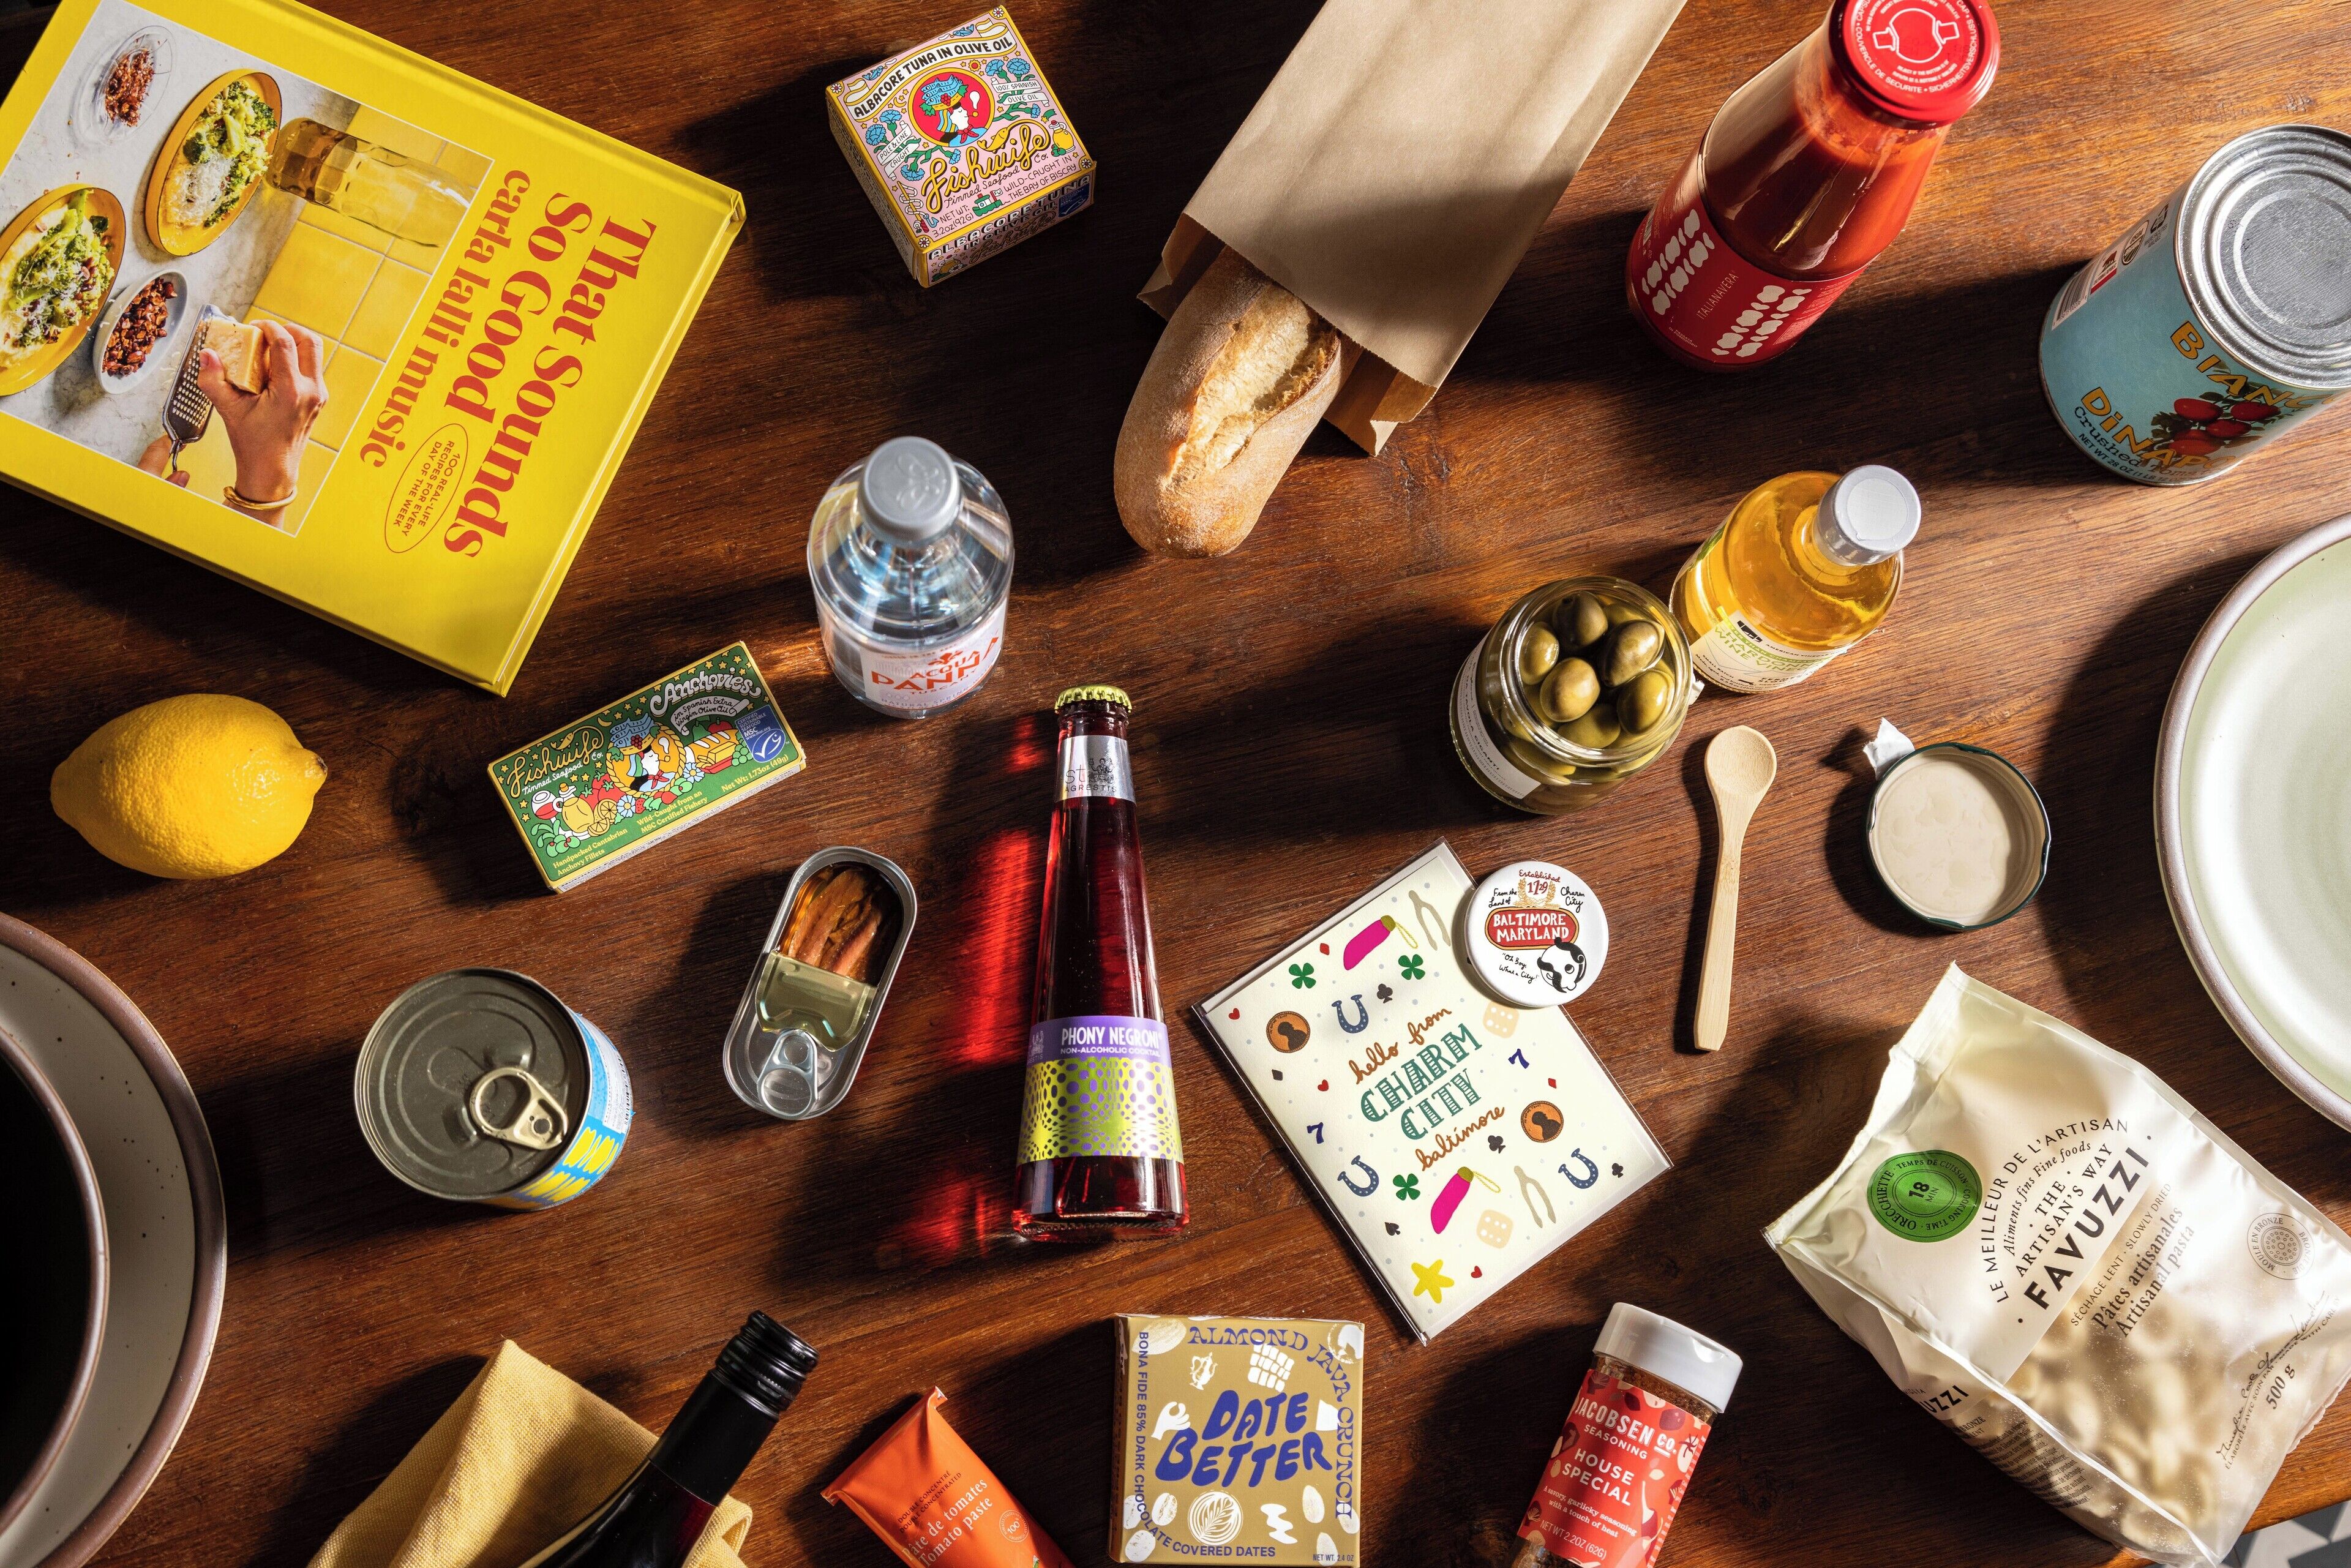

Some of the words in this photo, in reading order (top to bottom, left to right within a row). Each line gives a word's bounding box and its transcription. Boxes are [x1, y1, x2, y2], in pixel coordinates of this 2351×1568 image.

[1855, 26, 1877, 70] COUVERCLE
[1885, 75, 1922, 93] SECURITE
[1929, 19, 1977, 92] SICHERHEITSVERSCHLUSS
[853, 70, 905, 117] ALBACORE
[902, 53, 937, 75] TUNA
[938, 47, 953, 59] IN
[954, 41, 992, 56] OLIVE
[993, 37, 1013, 51] OIL
[1011, 81, 1038, 90] SPANISH
[879, 146, 894, 160] POLE
[896, 130, 909, 145] LINE
[890, 148, 910, 168] CAUGHT
[921, 131, 1051, 214] Fishwife
[944, 185, 981, 208] Tinned
[983, 165, 1020, 190] Seafood
[1003, 160, 1062, 192] WILD-CAUGHT
[1049, 163, 1076, 182] BISCAY
[464, 170, 531, 264] carla
[528, 192, 593, 262] So
[928, 203, 1032, 260] ALBACORE
[1037, 174, 1090, 203] TUNA
[553, 216, 657, 346] That
[1697, 273, 1739, 320] ITALIANAVERA
[422, 264, 491, 348] lalli
[444, 269, 552, 424] Good
[359, 346, 438, 468] music
[429, 441, 443, 461] DAY
[444, 346, 583, 558] Sounds
[2074, 405, 2142, 468] Crushed
[421, 463, 431, 476] OF
[429, 440, 455, 481] RECIPES
[444, 453, 460, 477] 100
[409, 479, 424, 497] THE
[418, 482, 433, 503] FOR
[418, 478, 448, 527] REAL-LIFE
[393, 499, 413, 527] WEEK
[402, 504, 422, 536] EVERY
[910, 651, 980, 679] ACQUA
[650, 667, 762, 717] Anchovies
[683, 698, 712, 712] Spanish
[713, 697, 733, 706] Extra
[744, 727, 758, 737] MSC
[746, 726, 771, 740] www.msc.org
[506, 726, 604, 798] Fishwife
[522, 779, 552, 795] Tinned
[552, 761, 583, 781] Seafood
[721, 782, 735, 792] Net
[734, 775, 748, 784] Wt:
[748, 764, 770, 779] 1.73oz
[770, 754, 789, 767] (49g)
[636, 803, 678, 826] Wild-Caught
[677, 793, 694, 806] from
[640, 822, 657, 833] MSC
[656, 808, 684, 827] Certified
[684, 797, 708, 812] Fishery
[553, 843, 591, 869] Handpacked
[591, 828, 628, 849] Cantabrian
[557, 859, 585, 876] Anchovy
[583, 849, 605, 864] Fillets
[1493, 888, 1508, 897] From
[1519, 869, 1561, 883] Established
[1527, 880, 1548, 895] 1729
[1561, 887, 1584, 897] Charm
[1493, 913, 1566, 927] BALTIMORE
[1565, 896, 1583, 913] City
[1497, 927, 1569, 943] MARYLAND
[1062, 1026, 1105, 1046] PHONY
[1109, 1027, 1160, 1049] NEGRONI
[1128, 1048, 1161, 1057] COCKTAIL
[1348, 1042, 1398, 1085] hello
[1407, 1008, 1452, 1045] from
[1360, 1022, 1483, 1123] CHARM
[1507, 1048, 1531, 1069] 7
[1400, 1068, 1482, 1140] CITY
[1307, 1122, 1324, 1144] 7
[1415, 1107, 1505, 1172] baltimore
[2027, 1117, 2128, 1154] L'ARTISAN
[1896, 1159, 1924, 1170] TEMPS
[1940, 1161, 1968, 1184] CUISSON
[2003, 1152, 2028, 1174] DE
[1877, 1170, 1917, 1231] ORECCHIETTE
[1908, 1182, 1930, 1198] 18
[1924, 1187, 1940, 1202] MIN
[1949, 1188, 1971, 1221] COOKING
[2003, 1200, 2022, 1256] Aliments
[2017, 1177, 2035, 1202] fins
[2033, 1157, 2058, 1177] Fine
[2060, 1141, 2091, 1163] foods
[2034, 1180, 2066, 1217] THE
[1981, 1178, 2008, 1273] MEILLEUR
[2015, 1185, 2084, 1277] ARTISAN'S
[2082, 1143, 2112, 1179] WAY
[2023, 1147, 2150, 1310] FAVUZZI
[2252, 1232, 2259, 1243] EN
[2071, 1281, 2107, 1326] SÉCHAGE
[2104, 1255, 2124, 1281] LENT
[2126, 1212, 2153, 1250] SLOWLY
[2151, 1183, 2172, 1212] DRIED
[2091, 1287, 2131, 1330] Pâtes
[2128, 1207, 2183, 1286] artisanales
[2253, 1246, 2275, 1271] MOULE
[1990, 1280, 2009, 1303] LE
[2115, 1261, 2171, 1338] Artisanal
[2167, 1225, 2195, 1269] pasta
[1138, 1332, 1149, 1368] BONA
[1137, 1373, 1148, 1401] FIDE
[2266, 1376, 2286, 1409] 500
[1136, 1404, 1147, 1431] 85%
[1187, 1326, 1308, 1351] ALMOND
[1306, 1344, 1351, 1402] JAVA
[1335, 1407, 1354, 1520] CRUNCH
[1201, 1389, 1309, 1442] DATE
[1574, 1397, 1655, 1447] JACOBSEN
[1656, 1433, 1678, 1454] CO.
[1135, 1435, 1146, 1471] DARK
[1155, 1427, 1333, 1488] BETTER
[1583, 1424, 1648, 1460] SEASONING
[2225, 1423, 2247, 1469] ÉLABORÉES
[1574, 1447, 1635, 1486] HOUSE
[919, 1470, 951, 1503] CONCENTRÉ
[920, 1472, 961, 1512] CONCENTRATED
[1562, 1463, 1632, 1507] SPECIAL
[902, 1536, 929, 1561] Pâte
[927, 1520, 944, 1537] de
[944, 1479, 988, 1521] tomates
[1134, 1476, 1172, 1547] CHOCOLATE
[1548, 1499, 1562, 1511] with
[1569, 1509, 1591, 1524] touch
[1567, 1497, 1599, 1517] garlicky
[1600, 1513, 1638, 1537] seasoning
[918, 1526, 962, 1567] Tomato
[962, 1498, 993, 1531] paste
[1172, 1541, 1232, 1556] COVERED
[1235, 1546, 1276, 1558] DATES
